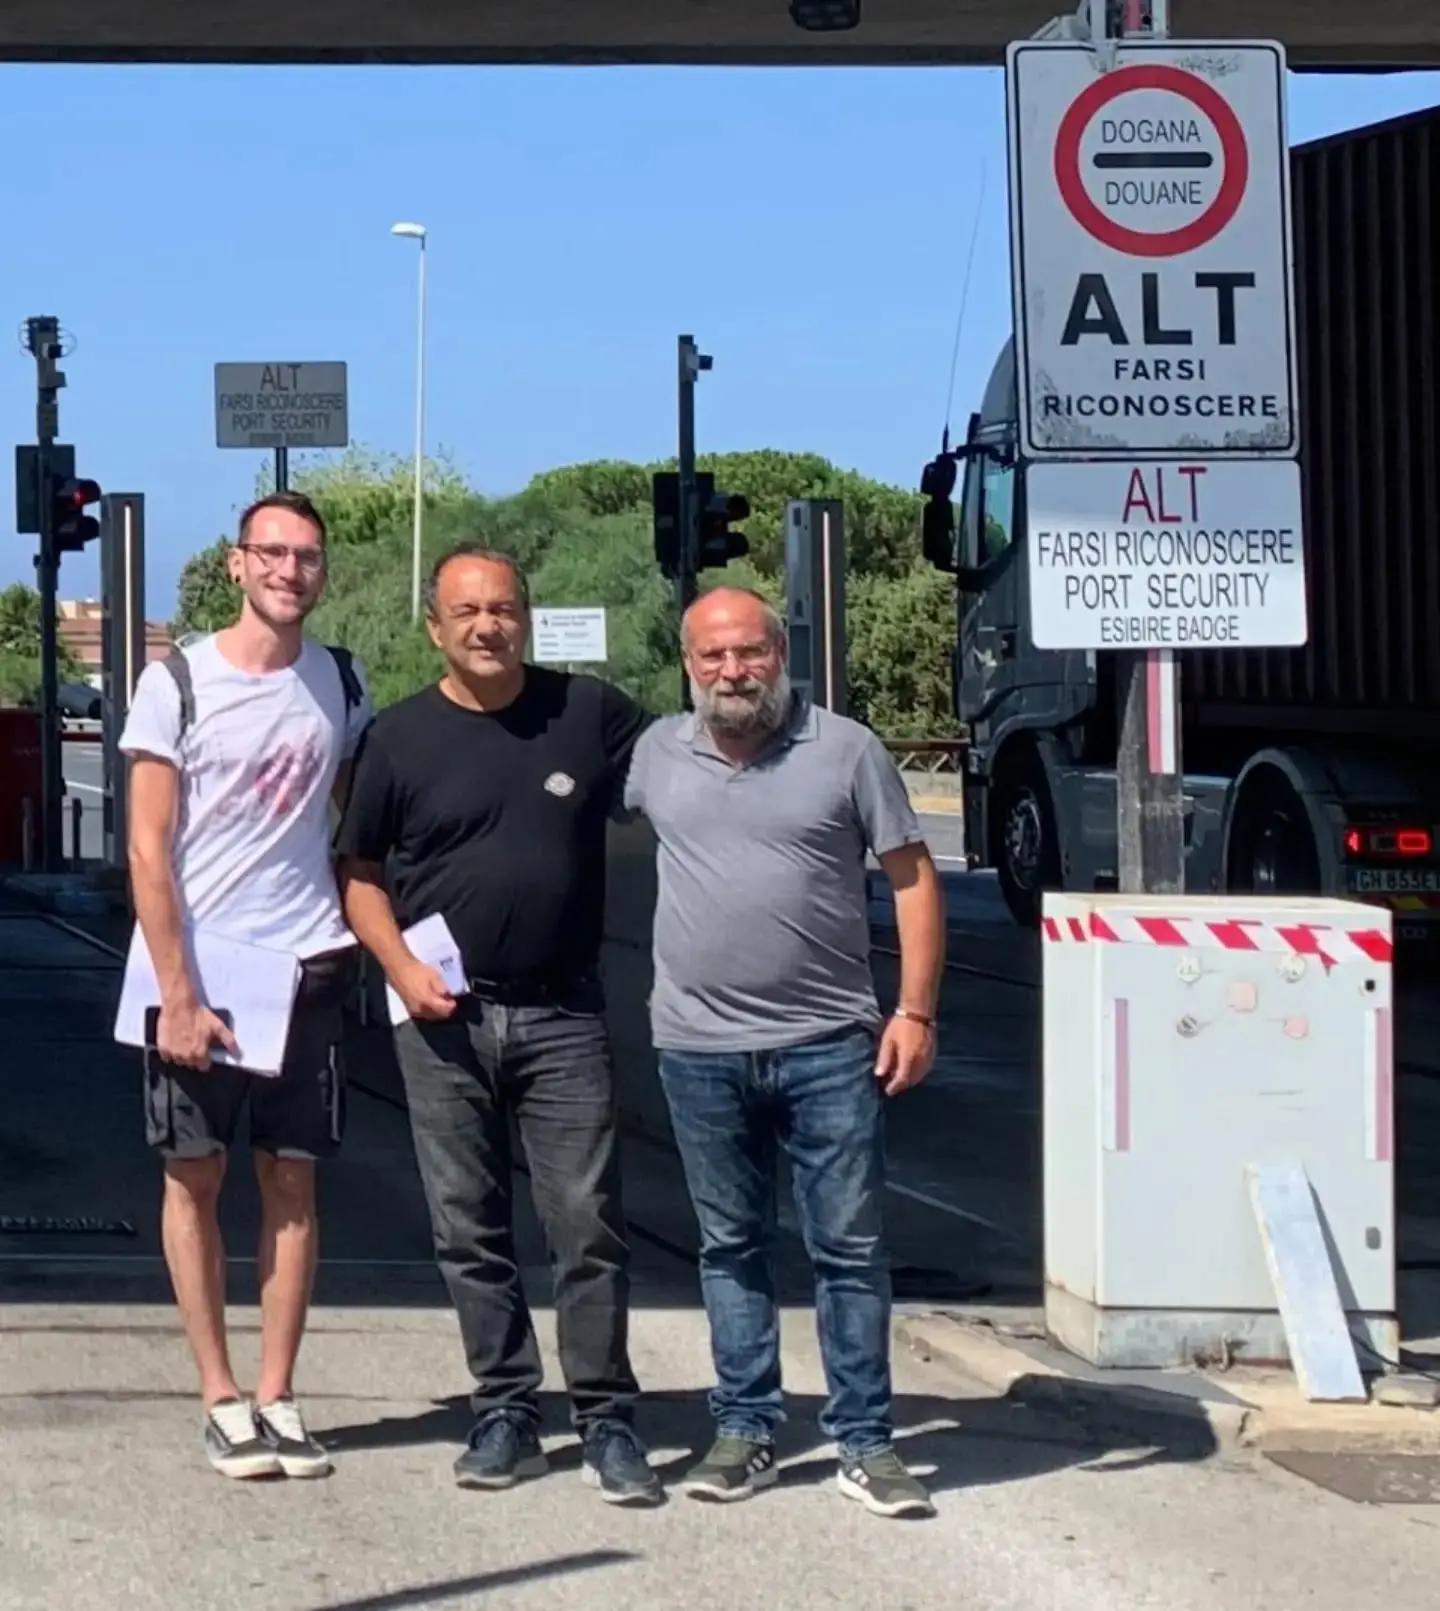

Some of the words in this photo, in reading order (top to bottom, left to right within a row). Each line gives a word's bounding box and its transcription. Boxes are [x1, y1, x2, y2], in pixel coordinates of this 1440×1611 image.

[1102, 119, 1201, 144] DOGANA
[1105, 181, 1203, 205] DOUANE
[1060, 272, 1256, 345] ALT
[260, 364, 302, 391] ALT
[1114, 359, 1206, 381] FARSI
[1043, 395, 1278, 417] RICONOSCERE
[1122, 466, 1207, 524] ALT
[1038, 532, 1108, 567] FARSI
[1115, 529, 1295, 567] RICONOSCERE
[1065, 574, 1133, 610] PORT
[1147, 572, 1270, 608] SECURITY
[1100, 616, 1172, 642] ESIBIRE
[1177, 615, 1240, 641] BADGE
